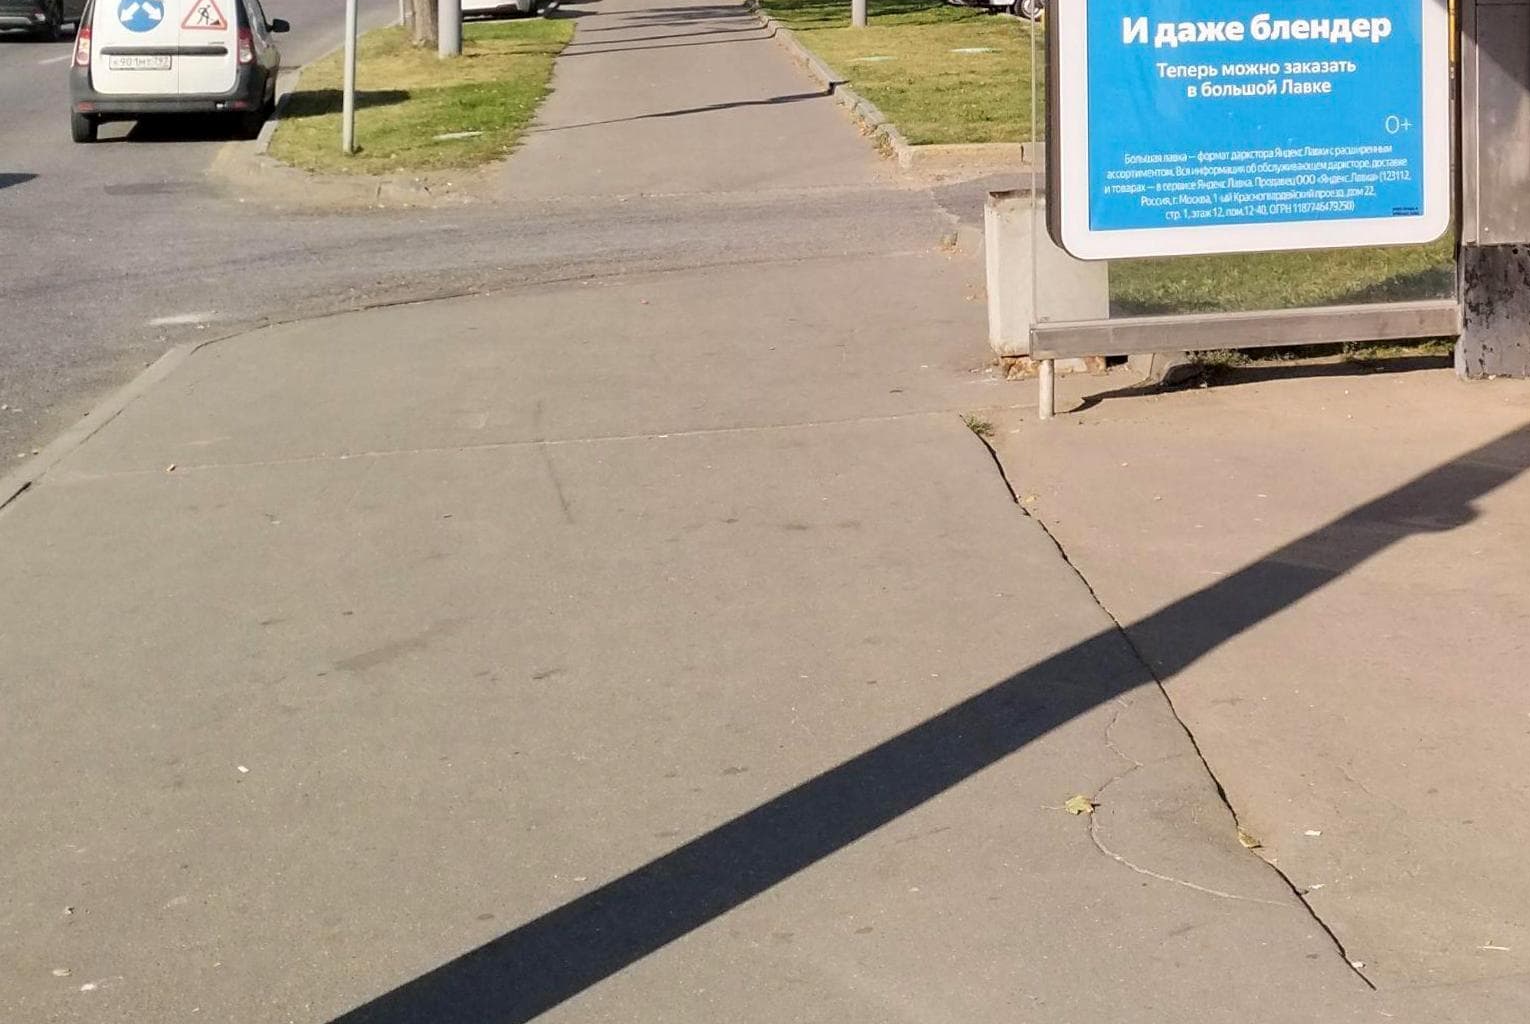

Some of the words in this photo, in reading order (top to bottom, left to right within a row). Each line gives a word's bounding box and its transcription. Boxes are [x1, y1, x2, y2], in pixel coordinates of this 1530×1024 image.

[1120, 16, 1148, 45] И
[1153, 19, 1245, 48] даже
[1251, 13, 1393, 44] блендер
[1156, 61, 1218, 80] Теперь
[1221, 62, 1280, 76] можно
[1283, 59, 1357, 75] заказать
[1187, 85, 1197, 98] в
[1200, 79, 1277, 97] большой
[1280, 79, 1332, 95] Лавке
[1385, 115, 1412, 134] 0+
[1197, 151, 1230, 162] формат
[1104, 184, 1111, 194] и
[1111, 184, 1146, 194] товарах
[1296, 174, 1316, 185] ООО
